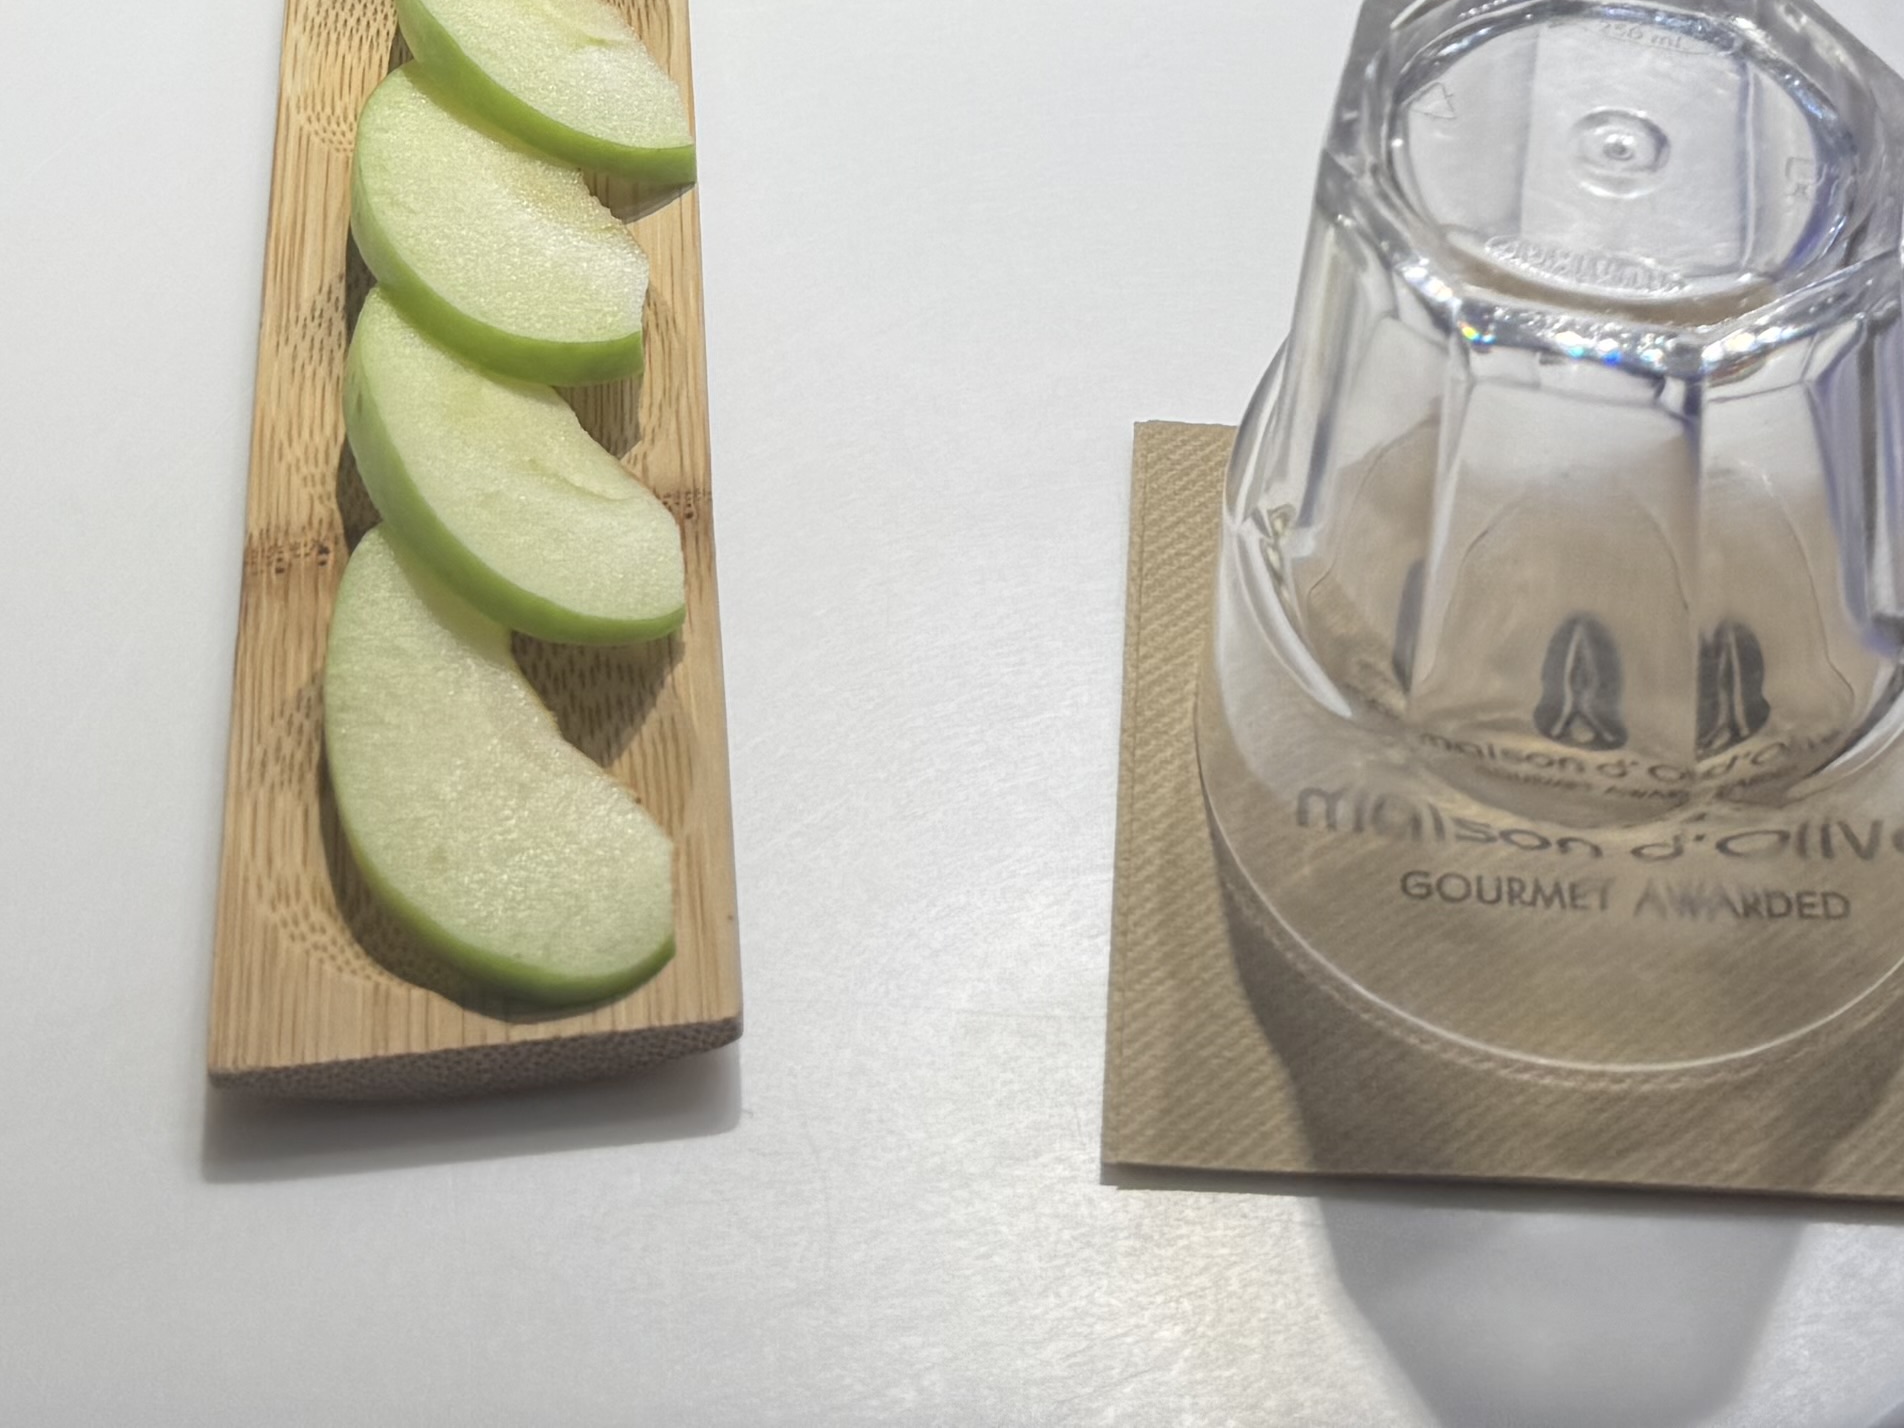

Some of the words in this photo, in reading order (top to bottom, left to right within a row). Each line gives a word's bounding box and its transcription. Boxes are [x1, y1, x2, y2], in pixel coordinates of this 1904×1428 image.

[1296, 785, 1604, 860] maison
[1399, 869, 1614, 913] GOURMET
[1633, 886, 1852, 921] AWARDED
